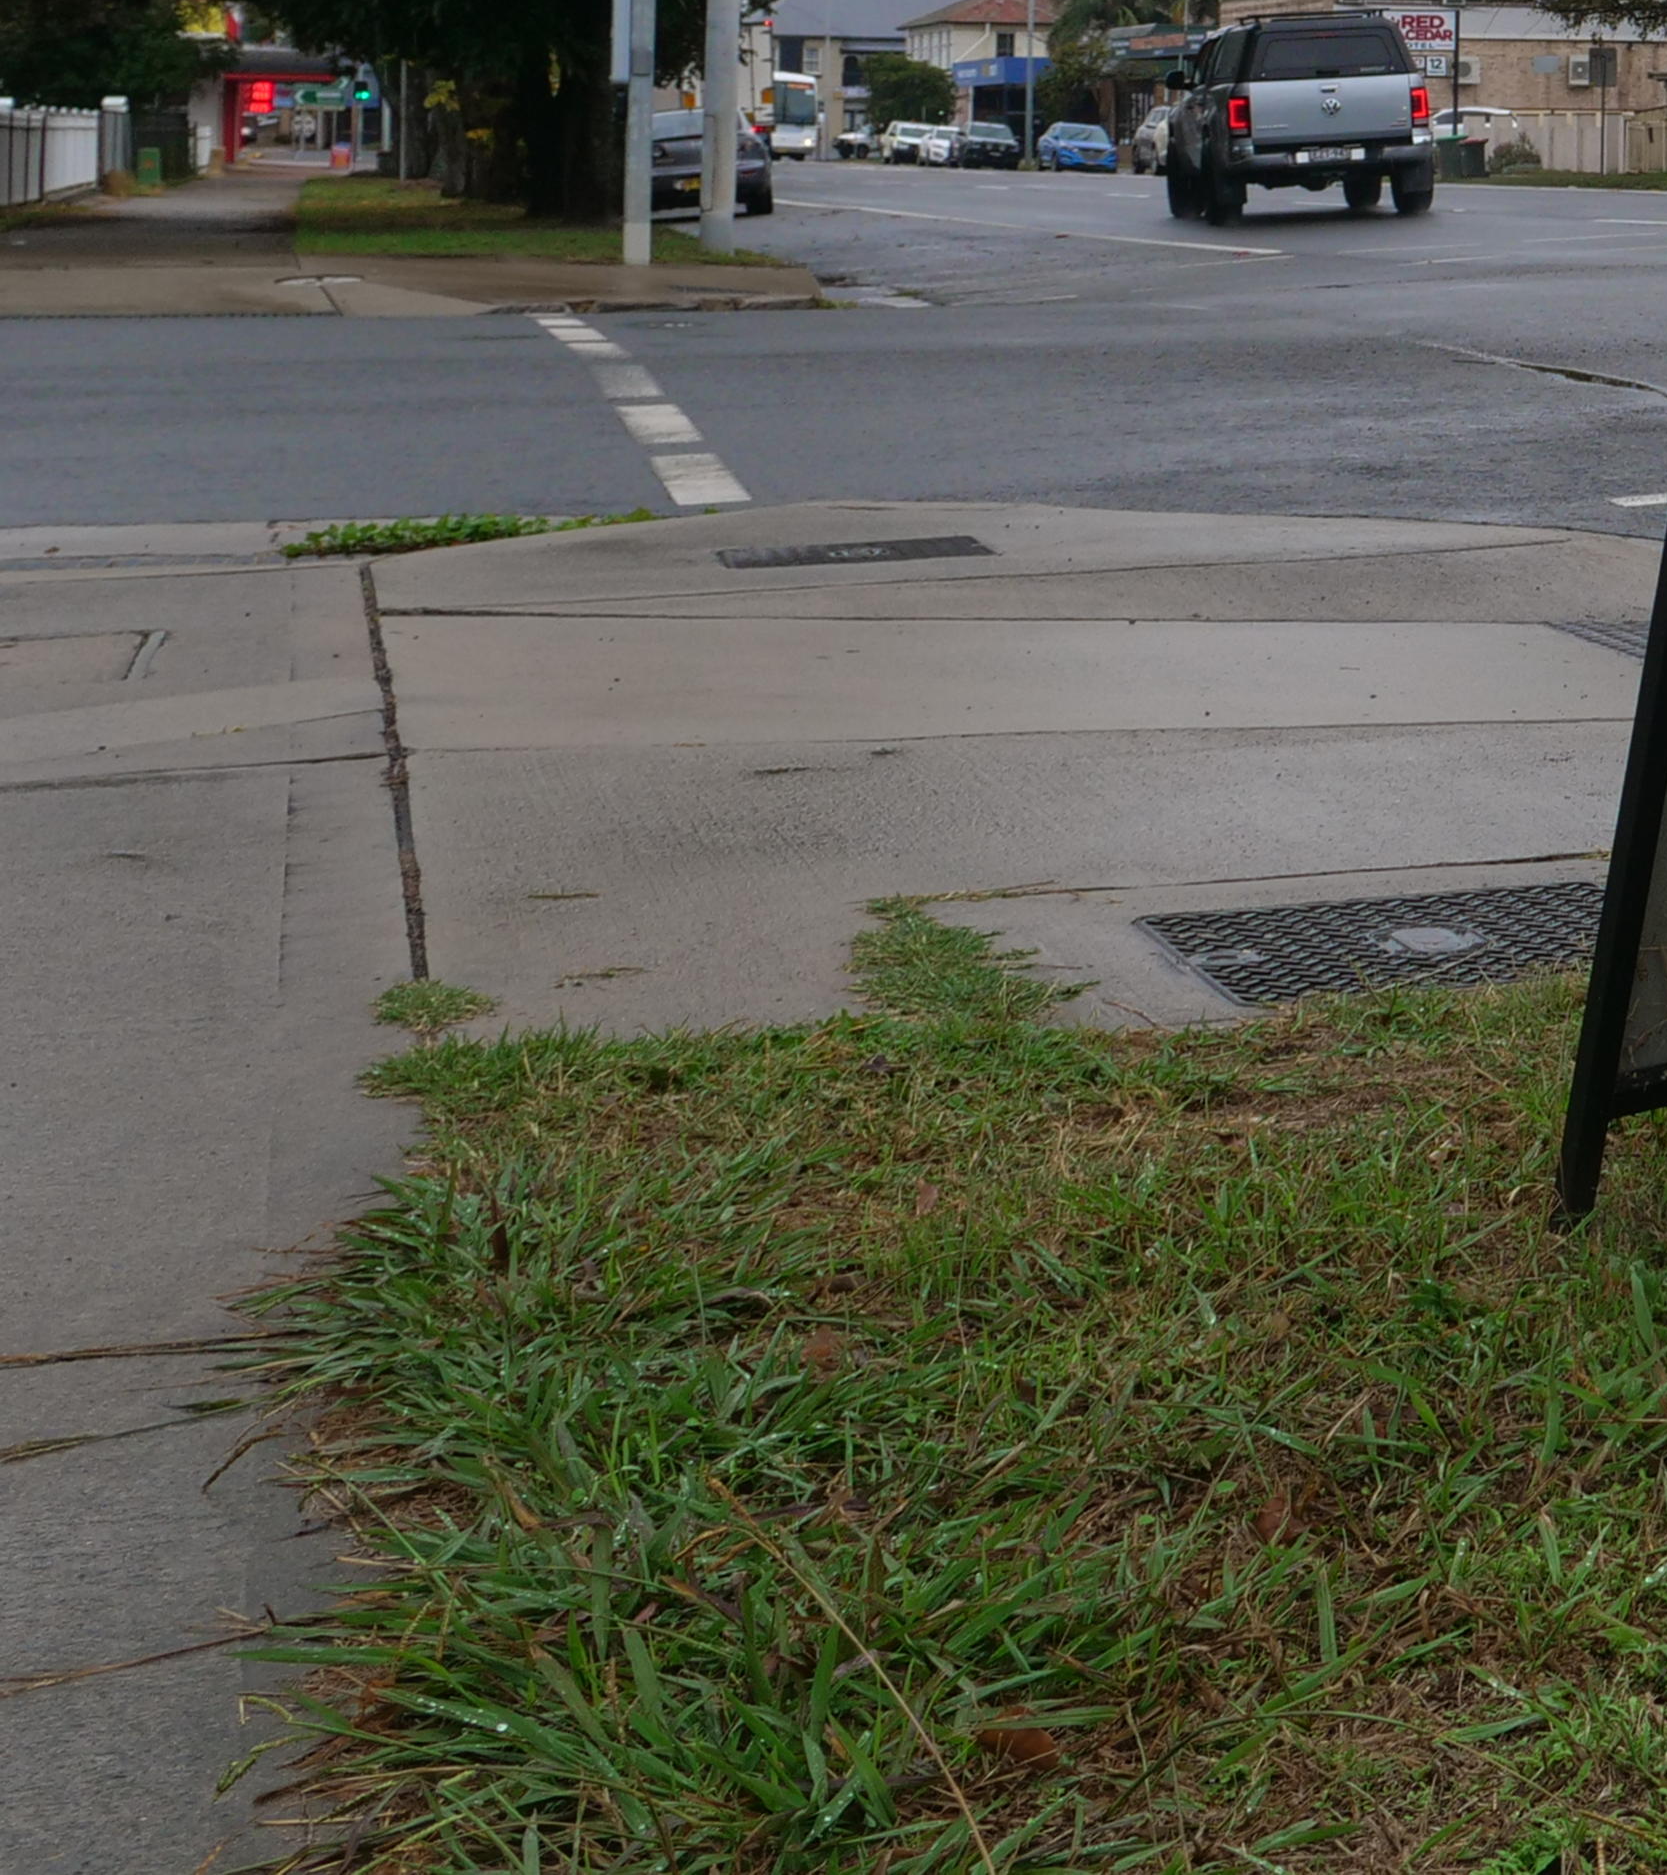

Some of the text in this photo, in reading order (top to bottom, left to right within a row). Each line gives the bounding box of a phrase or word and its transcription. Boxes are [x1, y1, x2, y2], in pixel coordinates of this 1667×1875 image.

[1401, 15, 1445, 29] RED
[1405, 29, 1454, 42] CEDAR
[1430, 59, 1443, 70] 12
